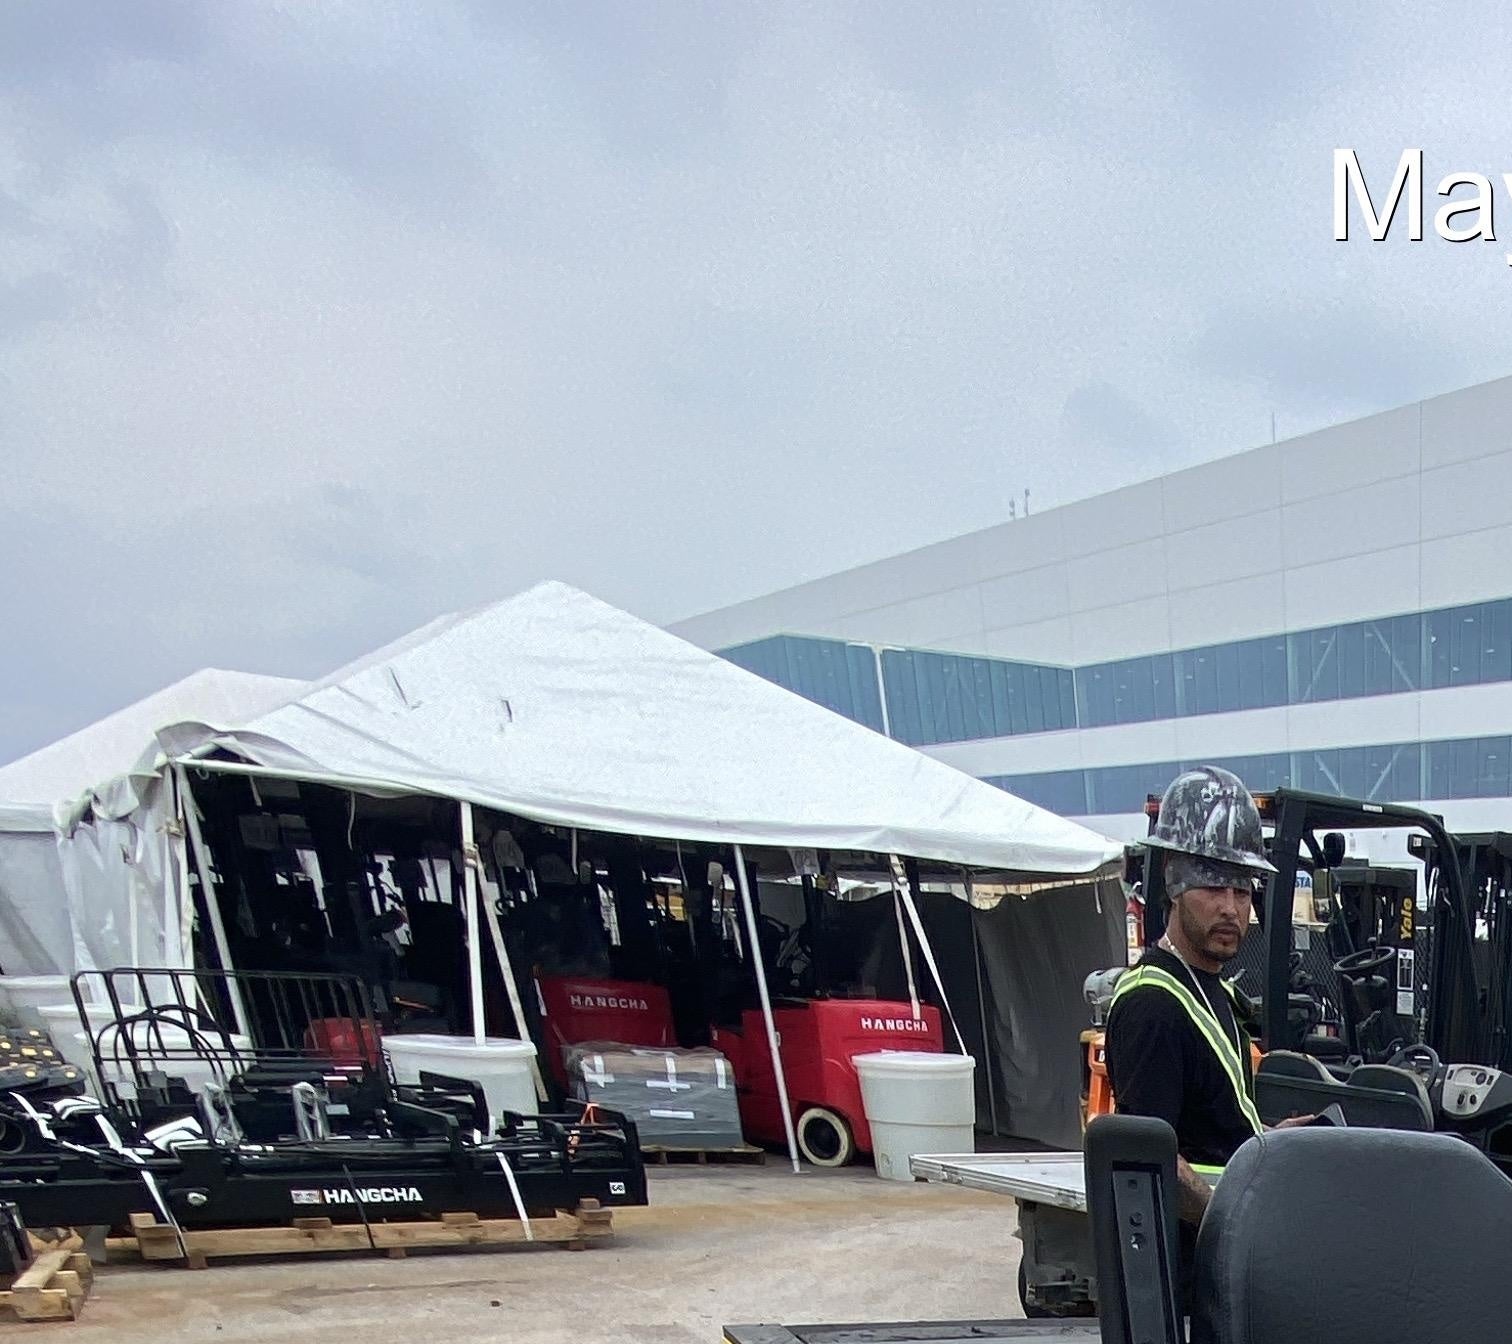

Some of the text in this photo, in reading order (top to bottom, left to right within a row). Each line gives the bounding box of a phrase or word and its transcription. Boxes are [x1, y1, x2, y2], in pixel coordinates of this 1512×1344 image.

[1400, 897, 1413, 940] Yale
[570, 995, 649, 1010] HANGCHA
[861, 1017, 929, 1032] HANGCHA
[322, 1187, 423, 1204] HANGCHA
